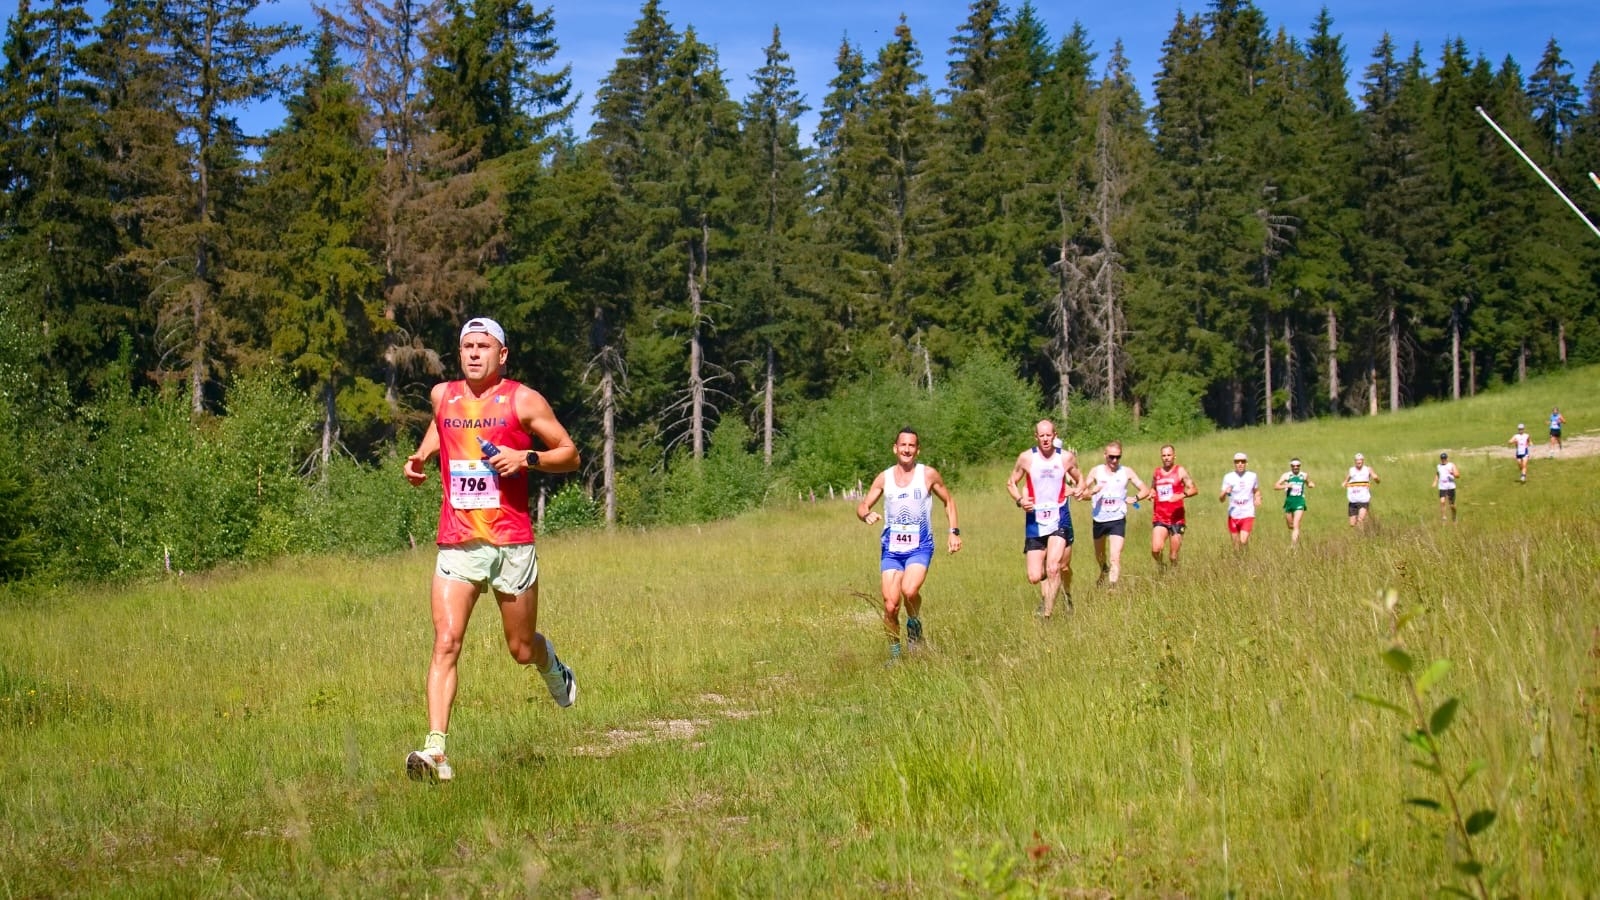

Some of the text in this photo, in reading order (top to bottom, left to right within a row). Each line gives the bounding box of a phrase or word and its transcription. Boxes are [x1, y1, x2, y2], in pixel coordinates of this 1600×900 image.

[443, 417, 507, 429] ROMANIA
[460, 478, 487, 492] 796
[896, 534, 912, 542] 441
